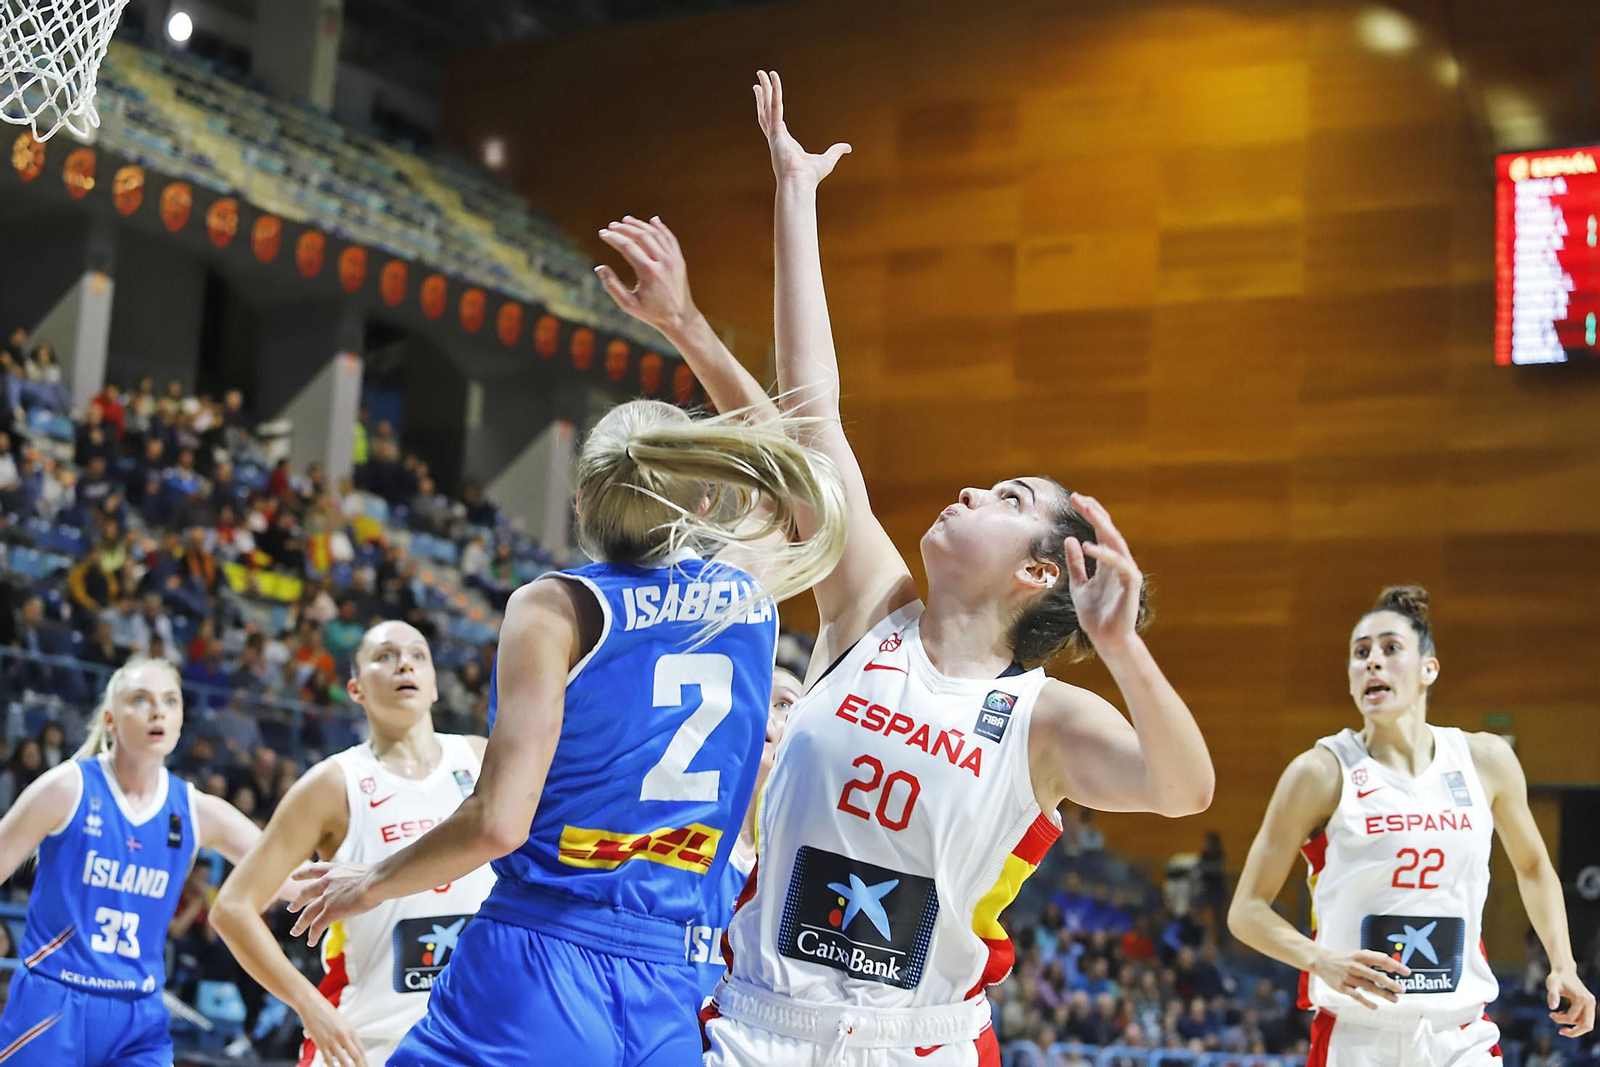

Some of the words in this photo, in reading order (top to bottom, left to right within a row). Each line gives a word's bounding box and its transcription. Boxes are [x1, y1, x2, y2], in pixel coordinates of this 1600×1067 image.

[640, 653, 734, 802] 2
[835, 694, 982, 778] ESPAÑA
[982, 713, 1005, 728] FIBA
[837, 754, 921, 832] 20
[381, 817, 443, 843] ESP
[1365, 809, 1473, 835] ESPAÑA
[82, 849, 170, 899] ÍSLAND
[1392, 848, 1445, 890] 22
[91, 906, 141, 959] 33
[684, 918, 727, 966] ÍSL
[797, 930, 901, 980] CaixaBank
[60, 969, 137, 990] ICELANDAIR
[1374, 973, 1453, 990] ixaBank
